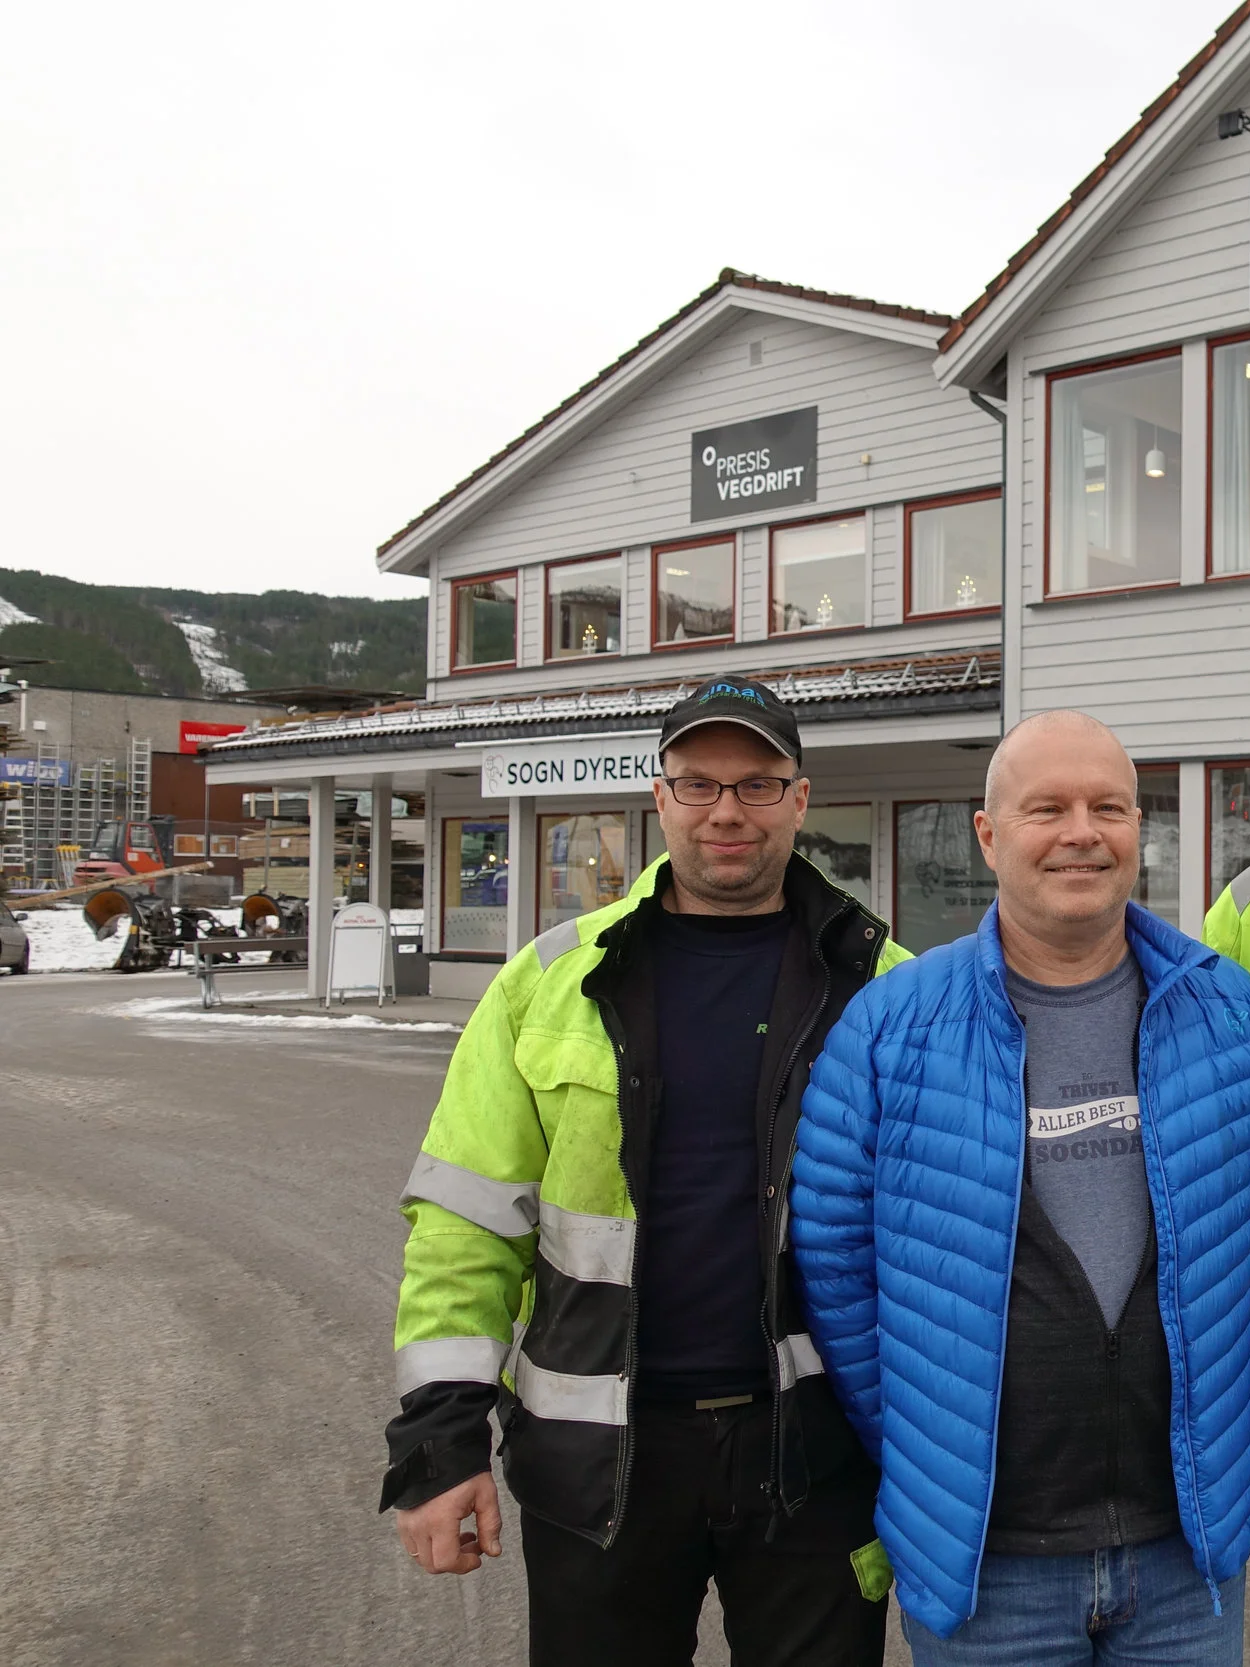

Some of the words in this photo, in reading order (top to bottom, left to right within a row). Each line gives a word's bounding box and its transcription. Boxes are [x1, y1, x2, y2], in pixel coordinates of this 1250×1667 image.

[717, 448, 770, 478] PRESIS
[717, 466, 804, 500] VEGDRIFT
[507, 760, 564, 785] SOGN
[1058, 1081, 1119, 1098] TRIVST
[1038, 1110, 1087, 1132] ALLER
[1088, 1101, 1125, 1121] BEST
